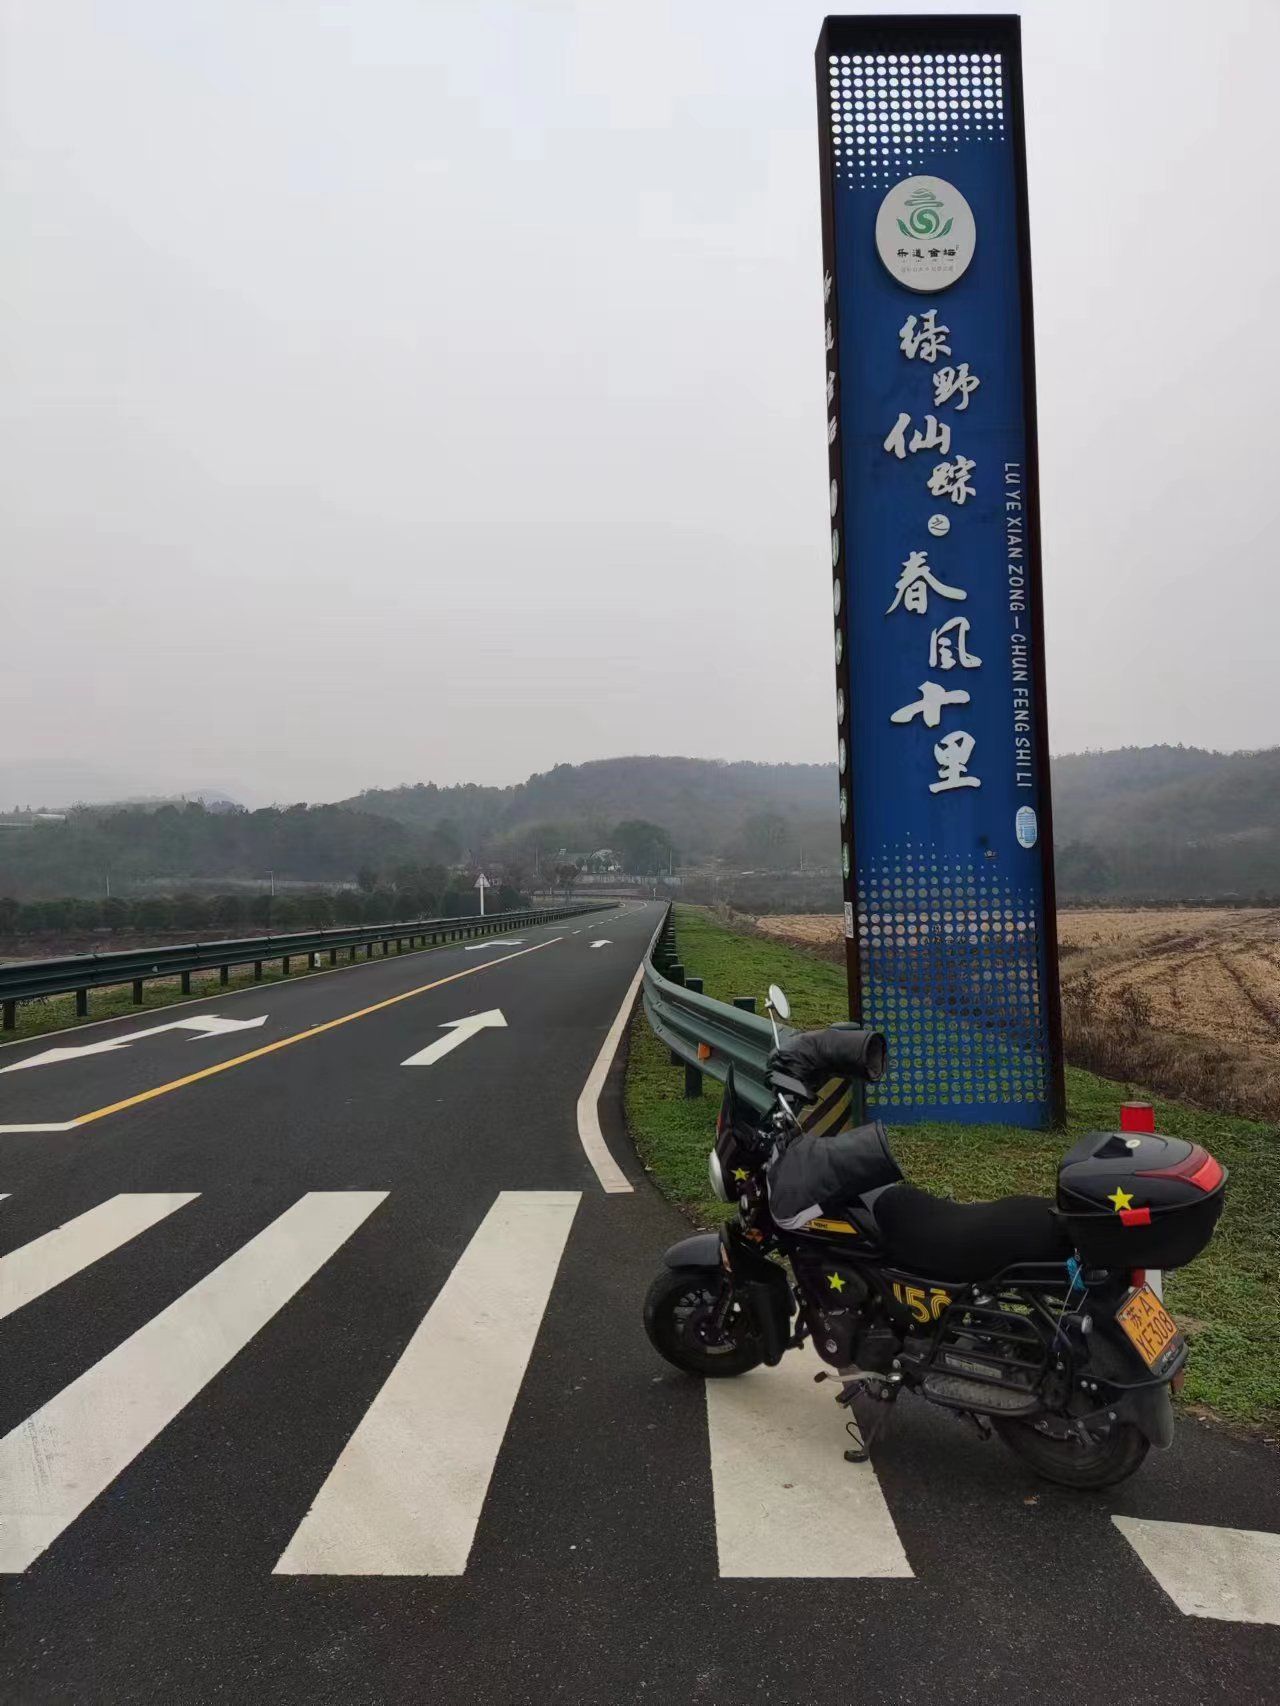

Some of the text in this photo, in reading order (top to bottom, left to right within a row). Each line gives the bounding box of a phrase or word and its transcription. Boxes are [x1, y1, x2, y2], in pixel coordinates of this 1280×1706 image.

[1004, 463, 1021, 484] LU
[1005, 490, 1022, 511] YE
[1006, 517, 1024, 558] XIAN
[1008, 564, 1026, 611] ZONG
[1011, 633, 1028, 682] CHUN
[1013, 688, 1031, 732] FENG
[1015, 737, 1032, 766] SHI
[1016, 772, 1033, 787] LI
[1136, 1310, 1174, 1362] XF308
